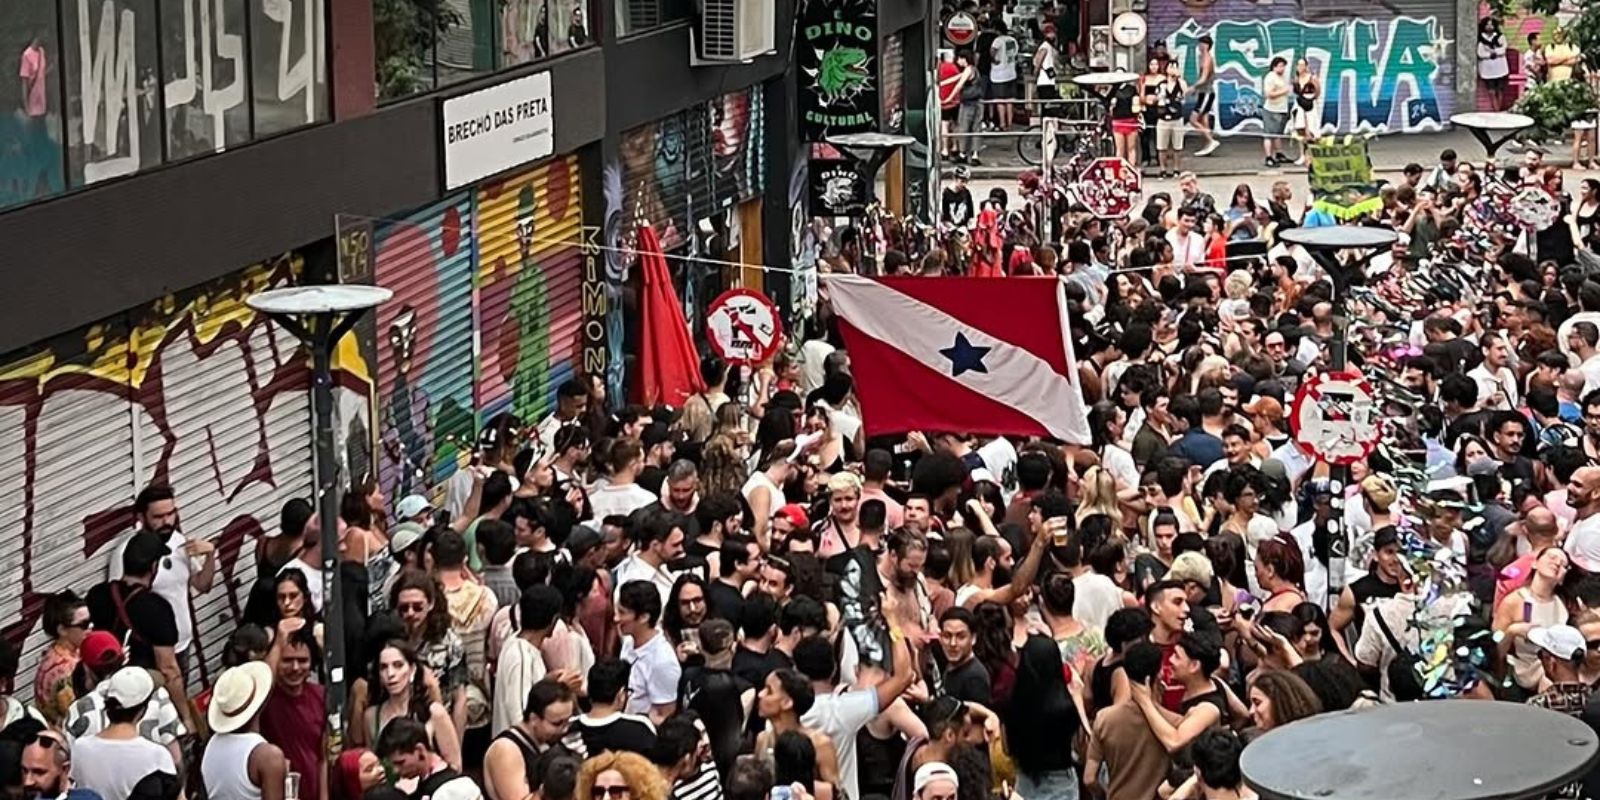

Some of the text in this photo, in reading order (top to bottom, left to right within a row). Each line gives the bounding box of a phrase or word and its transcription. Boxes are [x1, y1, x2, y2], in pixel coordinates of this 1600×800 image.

[804, 21, 872, 41] DINO
[494, 107, 515, 130] DAS
[516, 98, 548, 121] PRETA
[805, 110, 873, 126] CULTURAL
[821, 169, 858, 180] DINO
